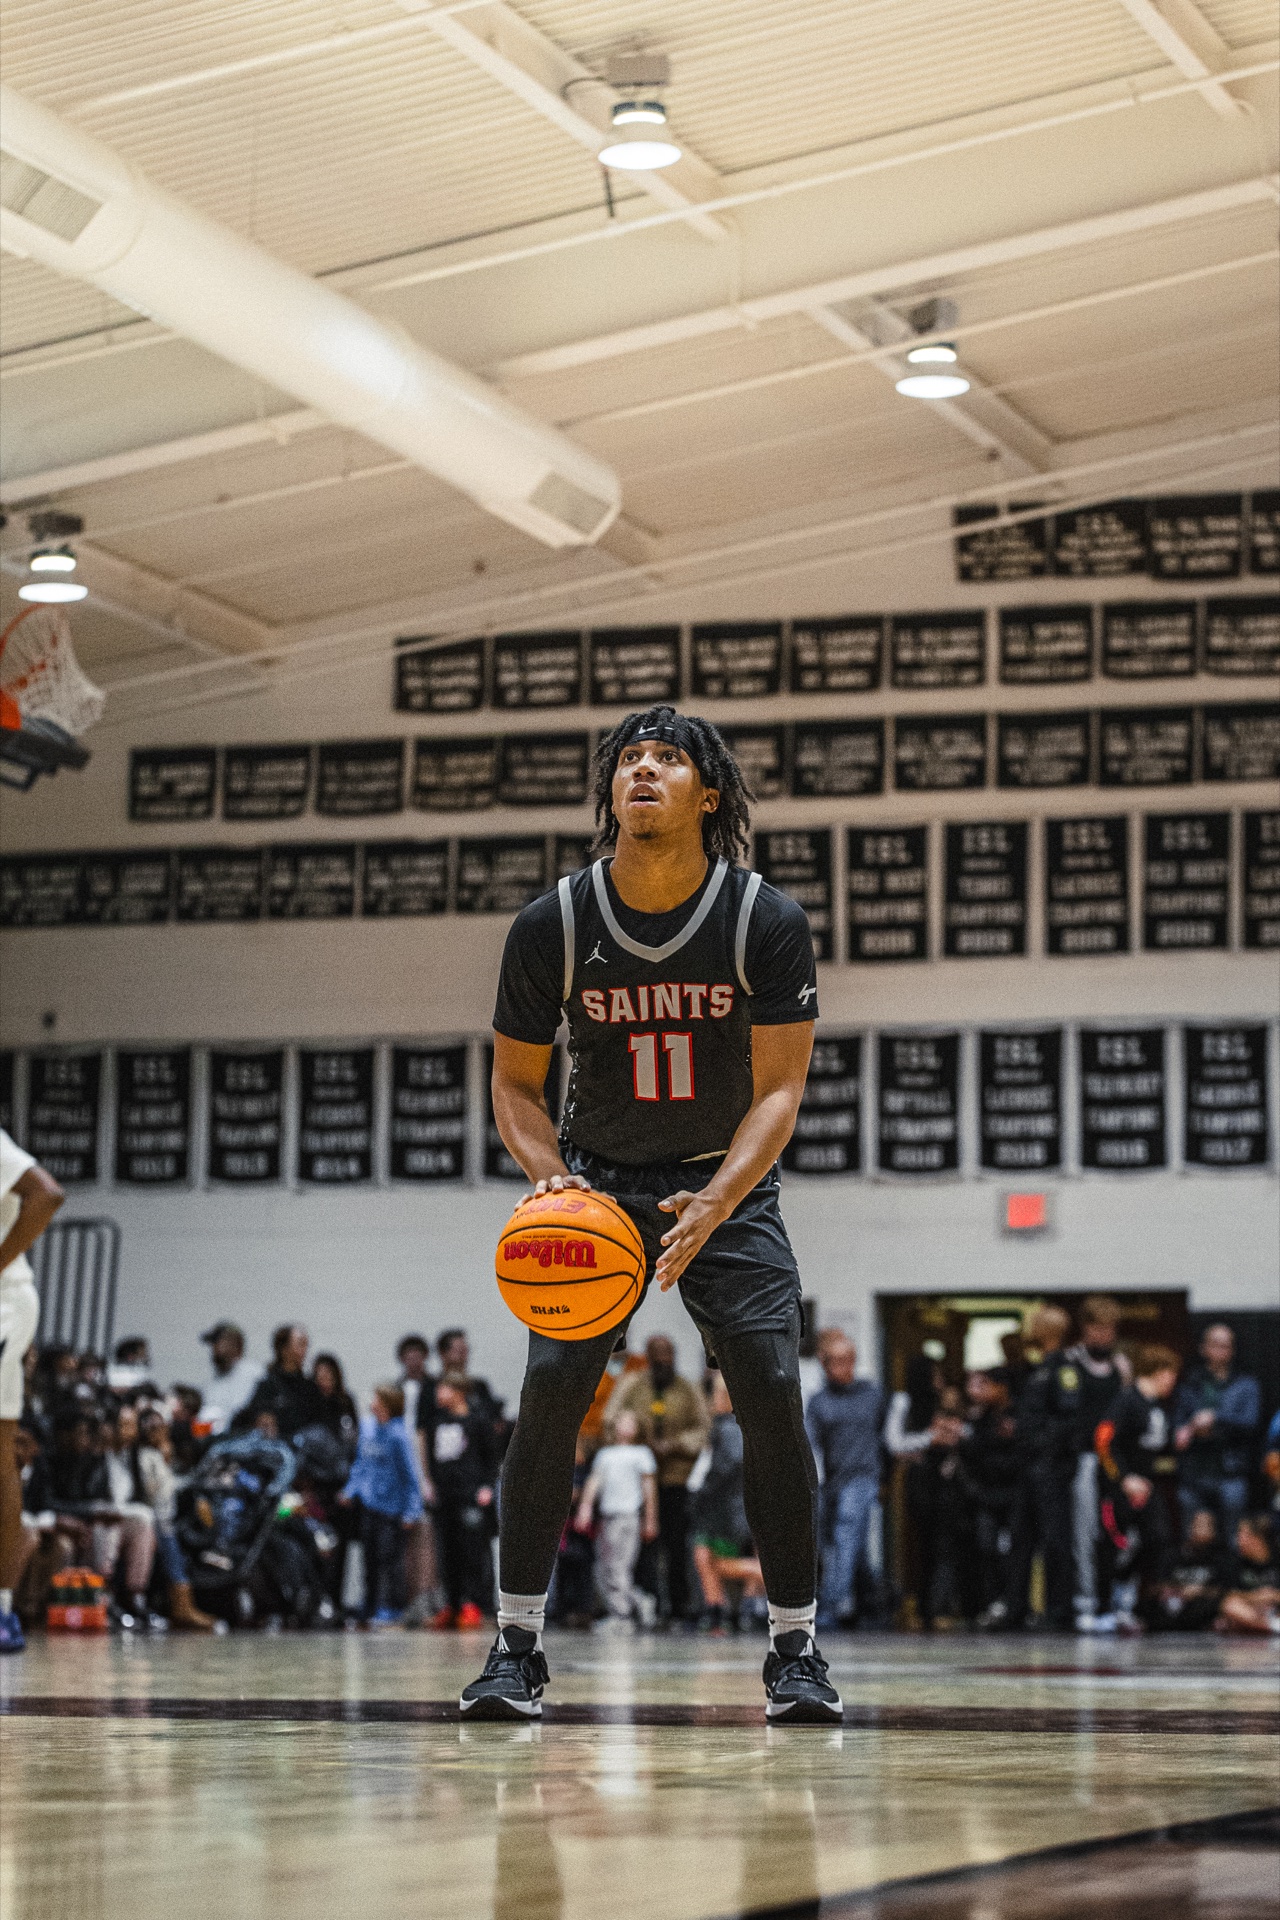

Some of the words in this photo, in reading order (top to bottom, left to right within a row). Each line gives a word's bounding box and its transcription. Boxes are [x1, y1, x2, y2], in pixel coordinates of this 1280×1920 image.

[581, 982, 734, 1023] SAINTS
[628, 1032, 695, 1101] 11
[504, 1240, 597, 1268] Wilson
[530, 1305, 561, 1314] NFHS
